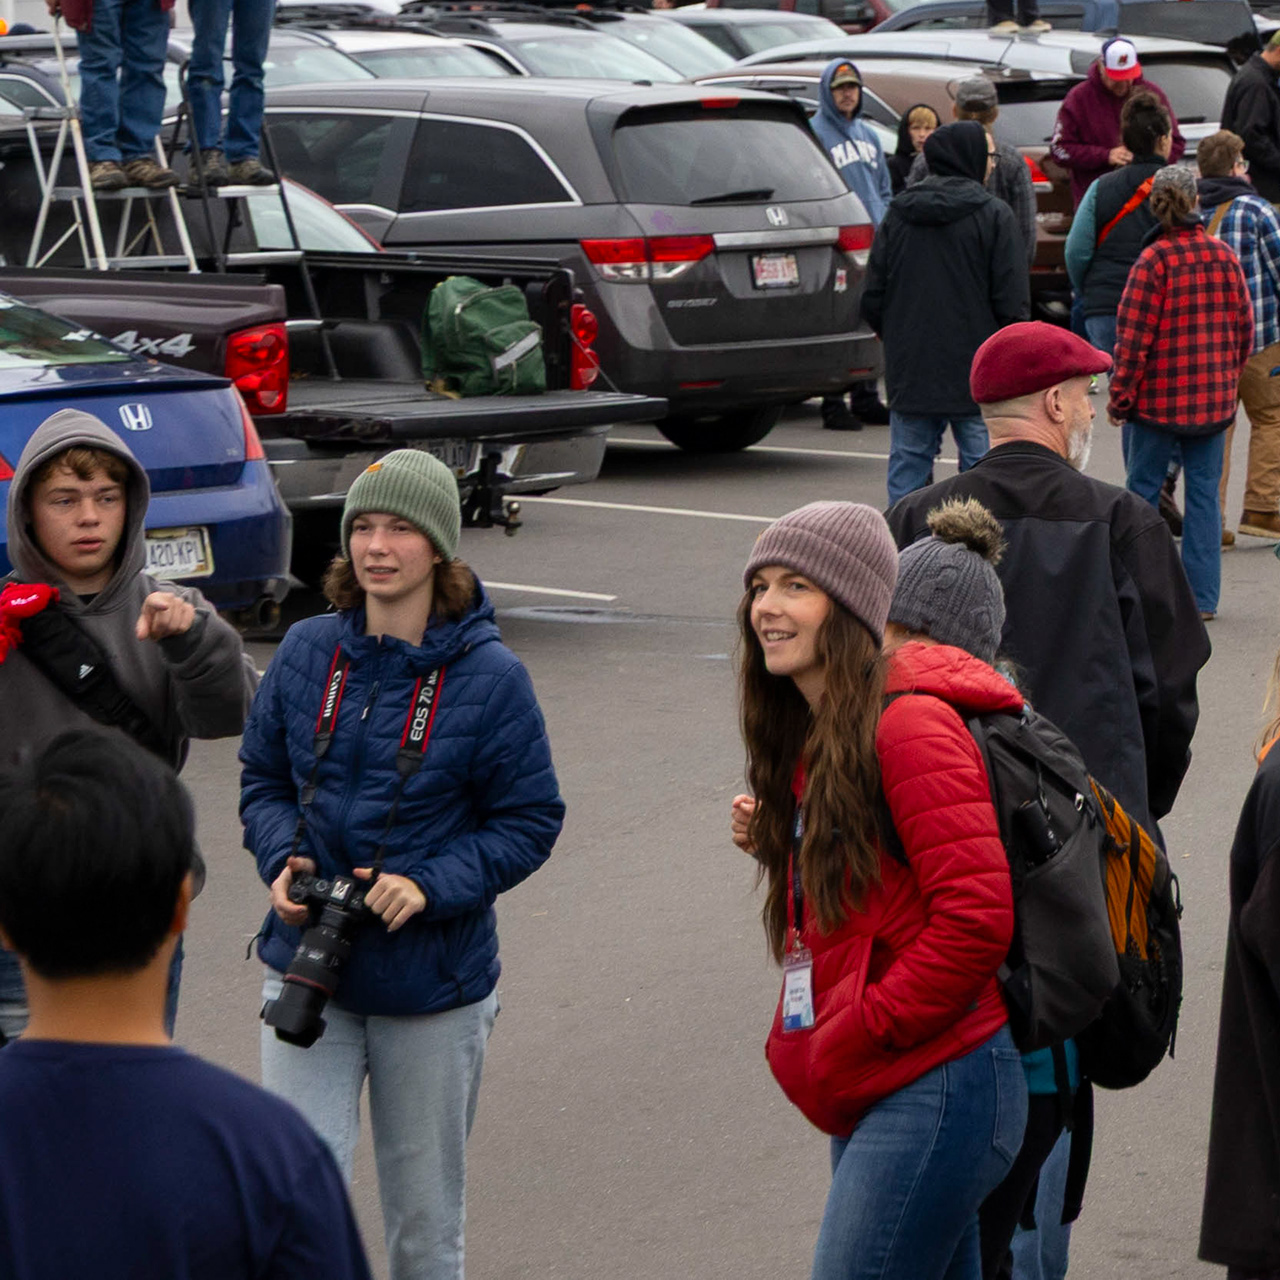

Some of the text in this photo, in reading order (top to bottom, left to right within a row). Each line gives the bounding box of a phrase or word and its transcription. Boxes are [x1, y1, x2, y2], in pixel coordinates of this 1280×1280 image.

[110, 330, 197, 358] 4x4
[144, 541, 205, 570] 420-KPL
[323, 670, 342, 717] Canon
[418, 686, 434, 704] 7D
[410, 707, 429, 741] EOS
